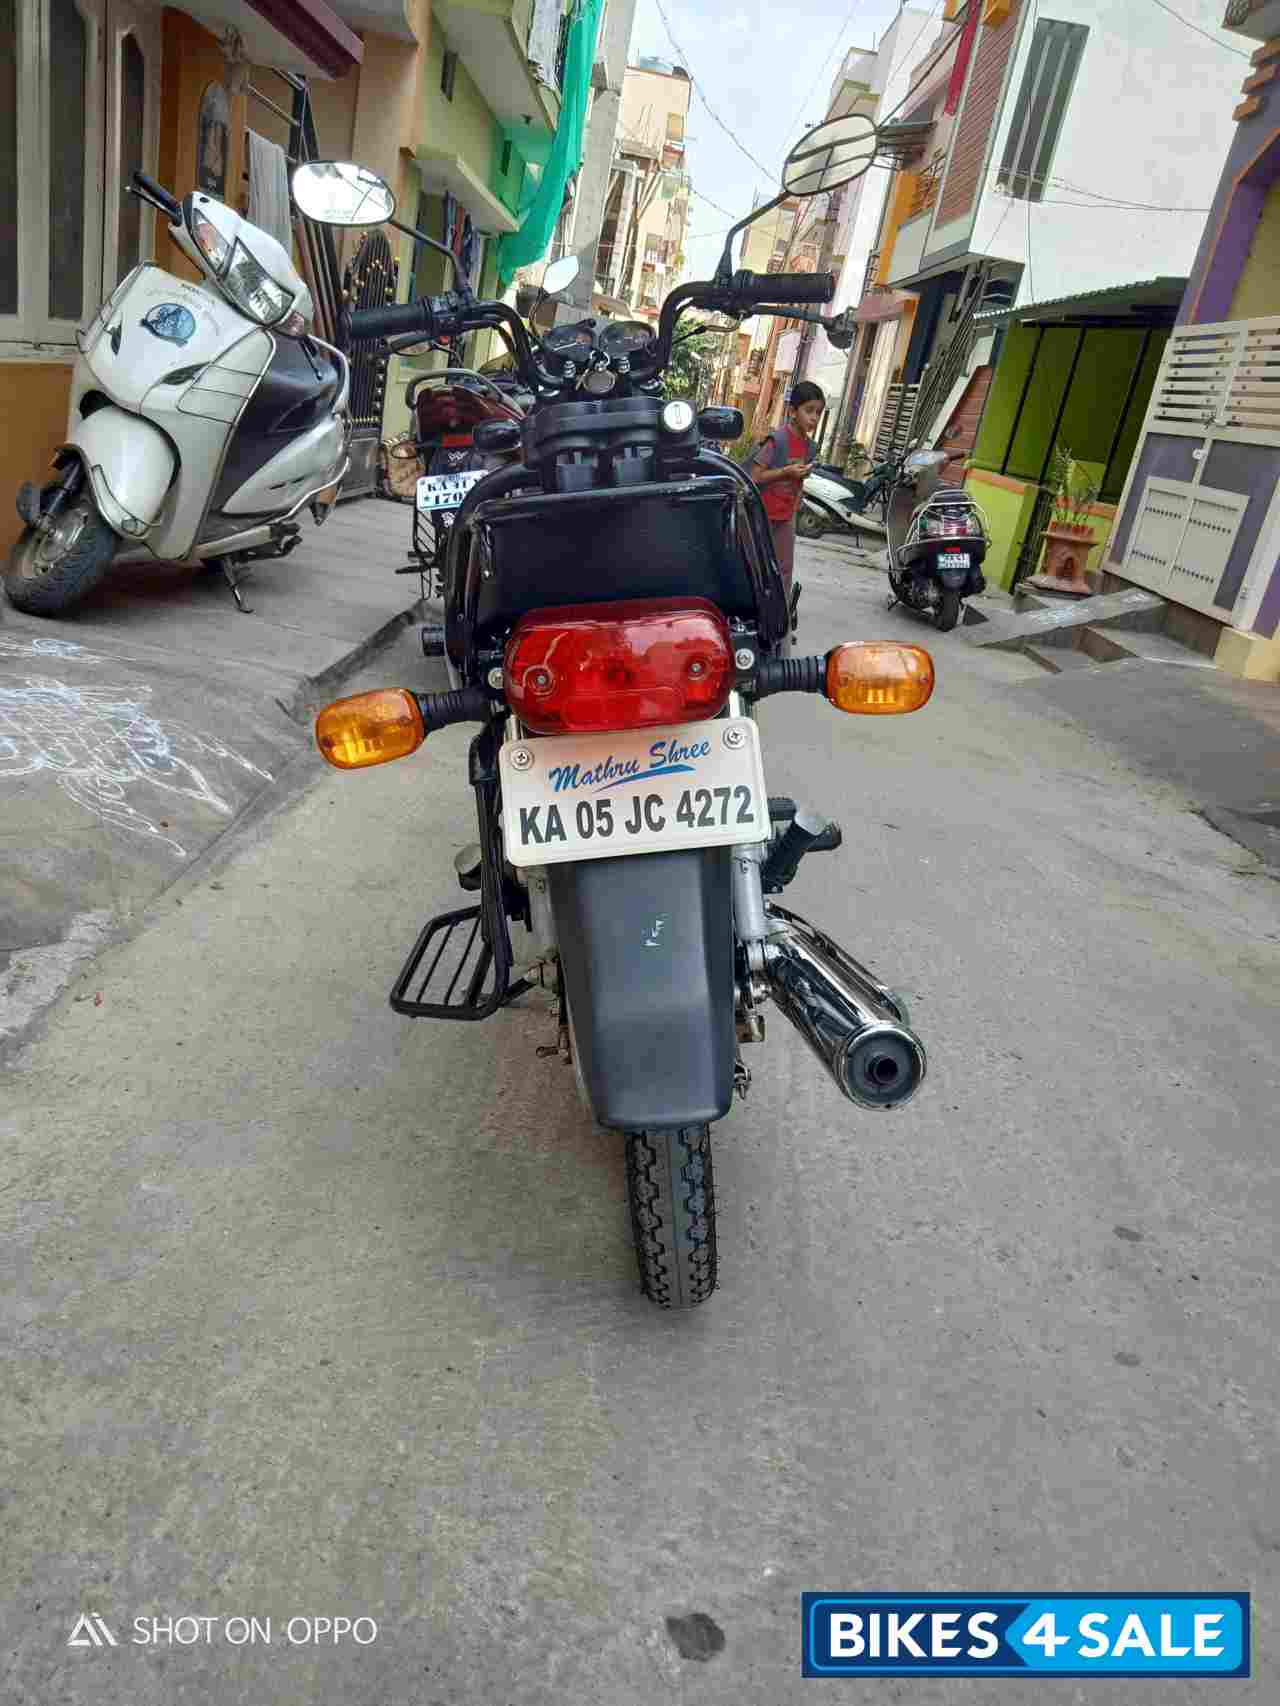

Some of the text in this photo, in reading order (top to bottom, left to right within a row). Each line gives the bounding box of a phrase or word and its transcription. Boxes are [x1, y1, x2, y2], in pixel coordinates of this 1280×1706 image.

[549, 740, 711, 793] Mathru Shree
[519, 784, 755, 845] KA 05 JC 4272
